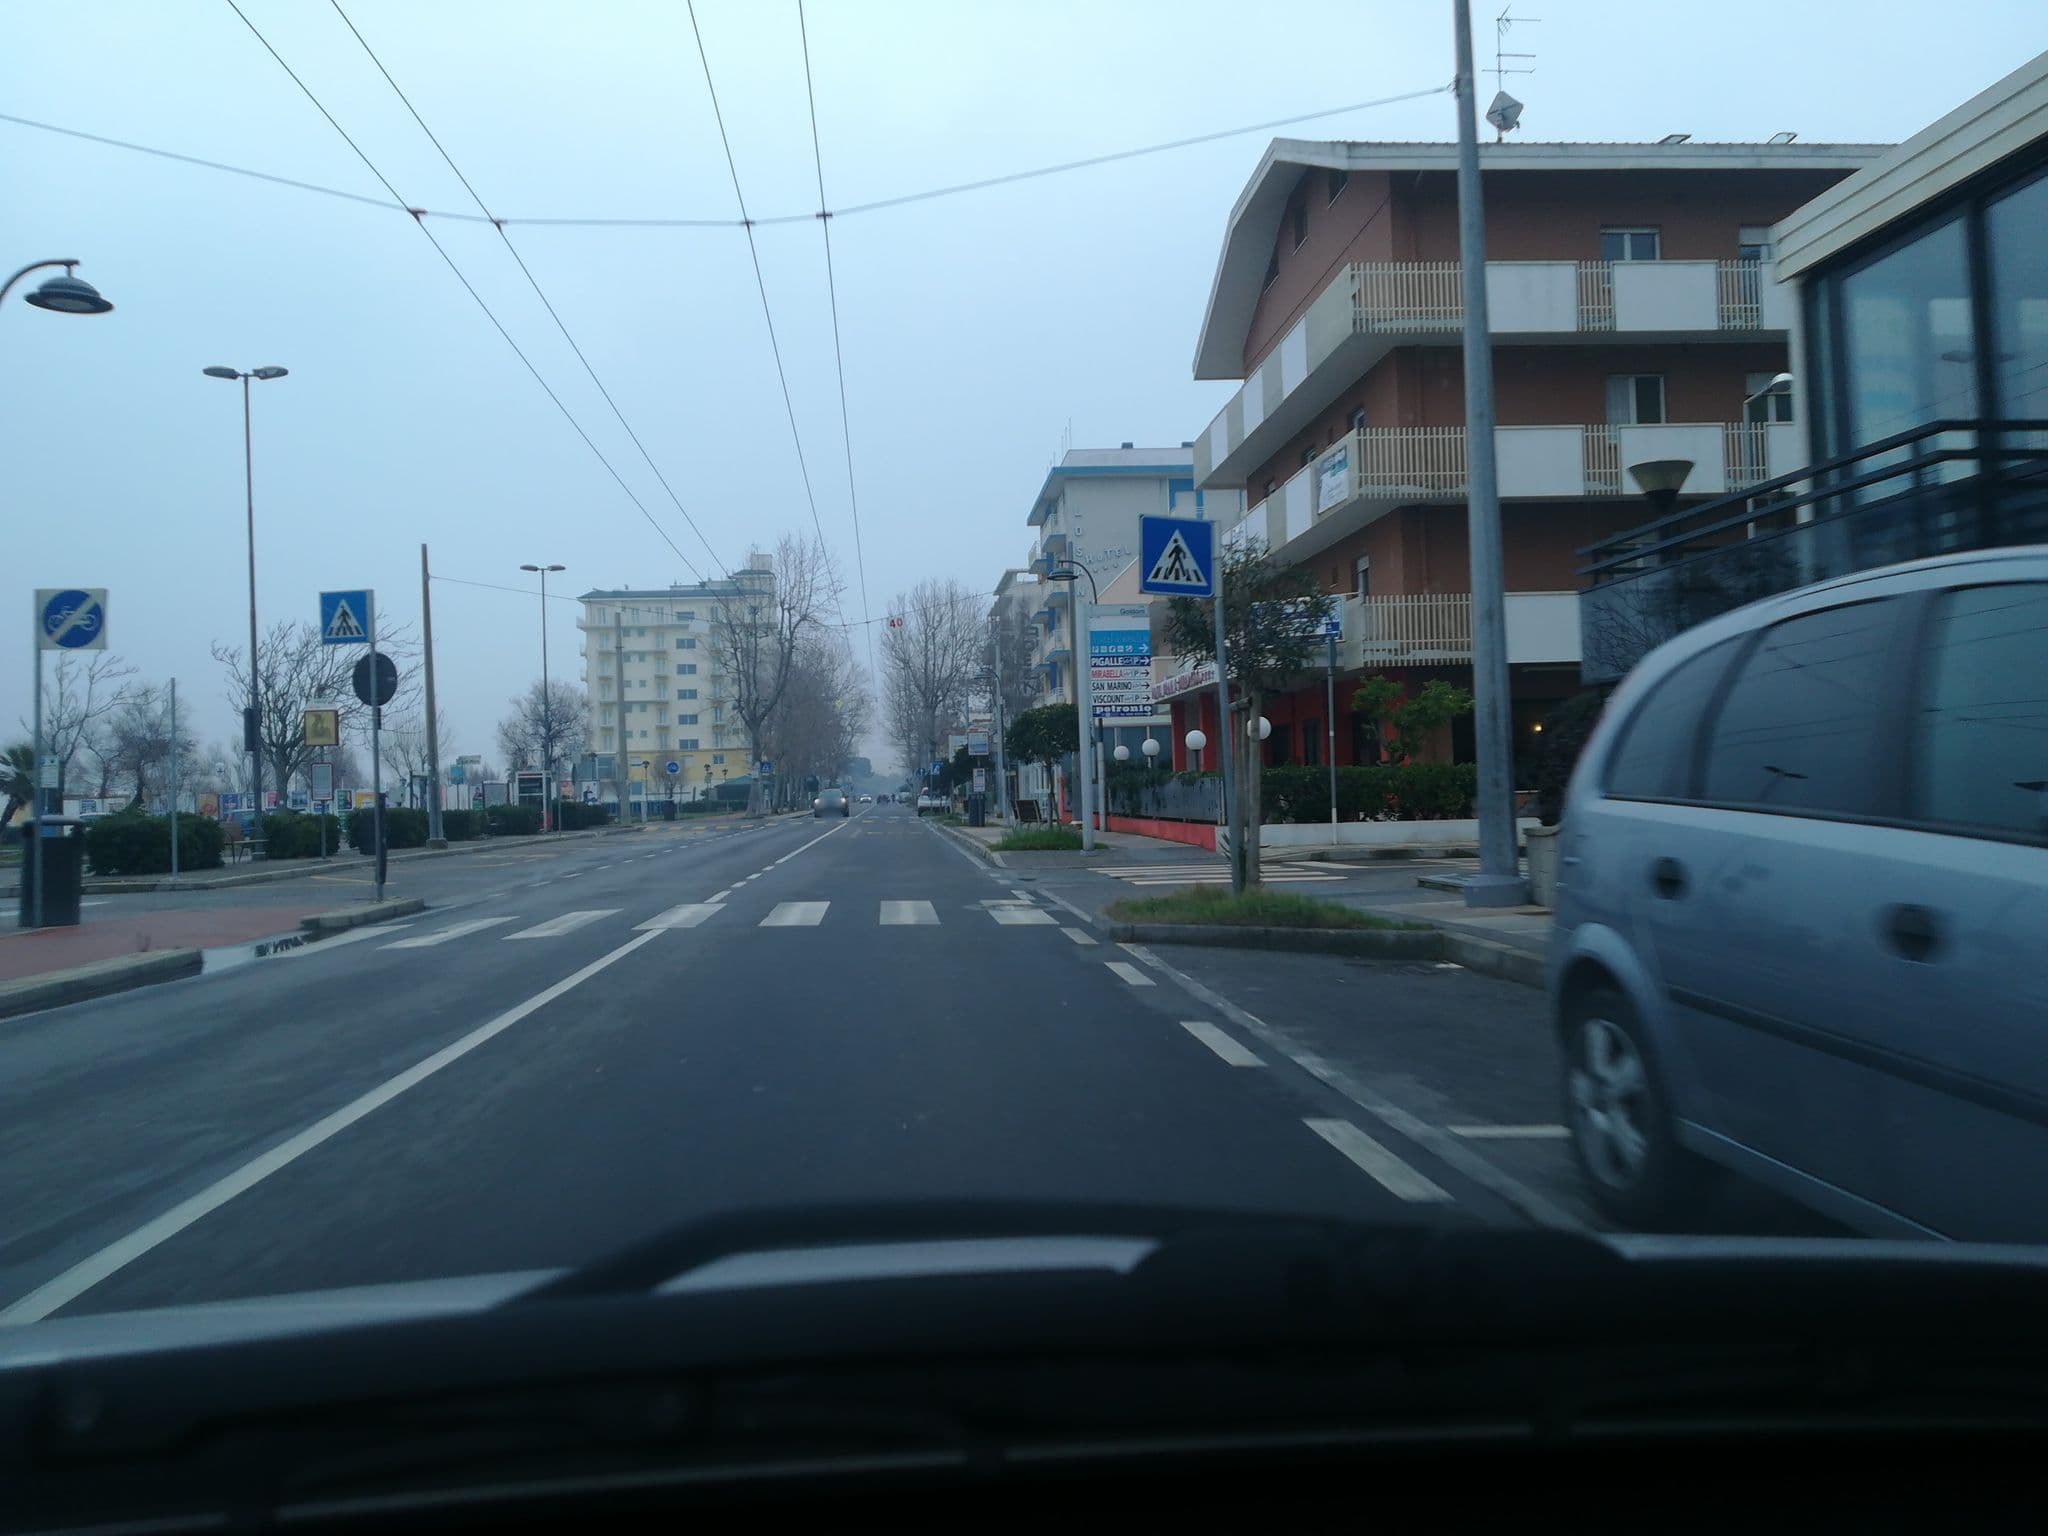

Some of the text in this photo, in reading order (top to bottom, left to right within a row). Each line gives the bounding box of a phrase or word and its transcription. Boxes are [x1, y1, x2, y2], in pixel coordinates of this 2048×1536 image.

[1085, 547, 1131, 565] HOTEL
[889, 617, 903, 629] 40
[1091, 656, 1123, 666] PIGALLE
[1091, 670, 1123, 679] MIRABELLA
[1091, 681, 1132, 691] SAN MARINO
[1092, 694, 1125, 704] VISCOUNT
[1096, 705, 1152, 714] petronio
